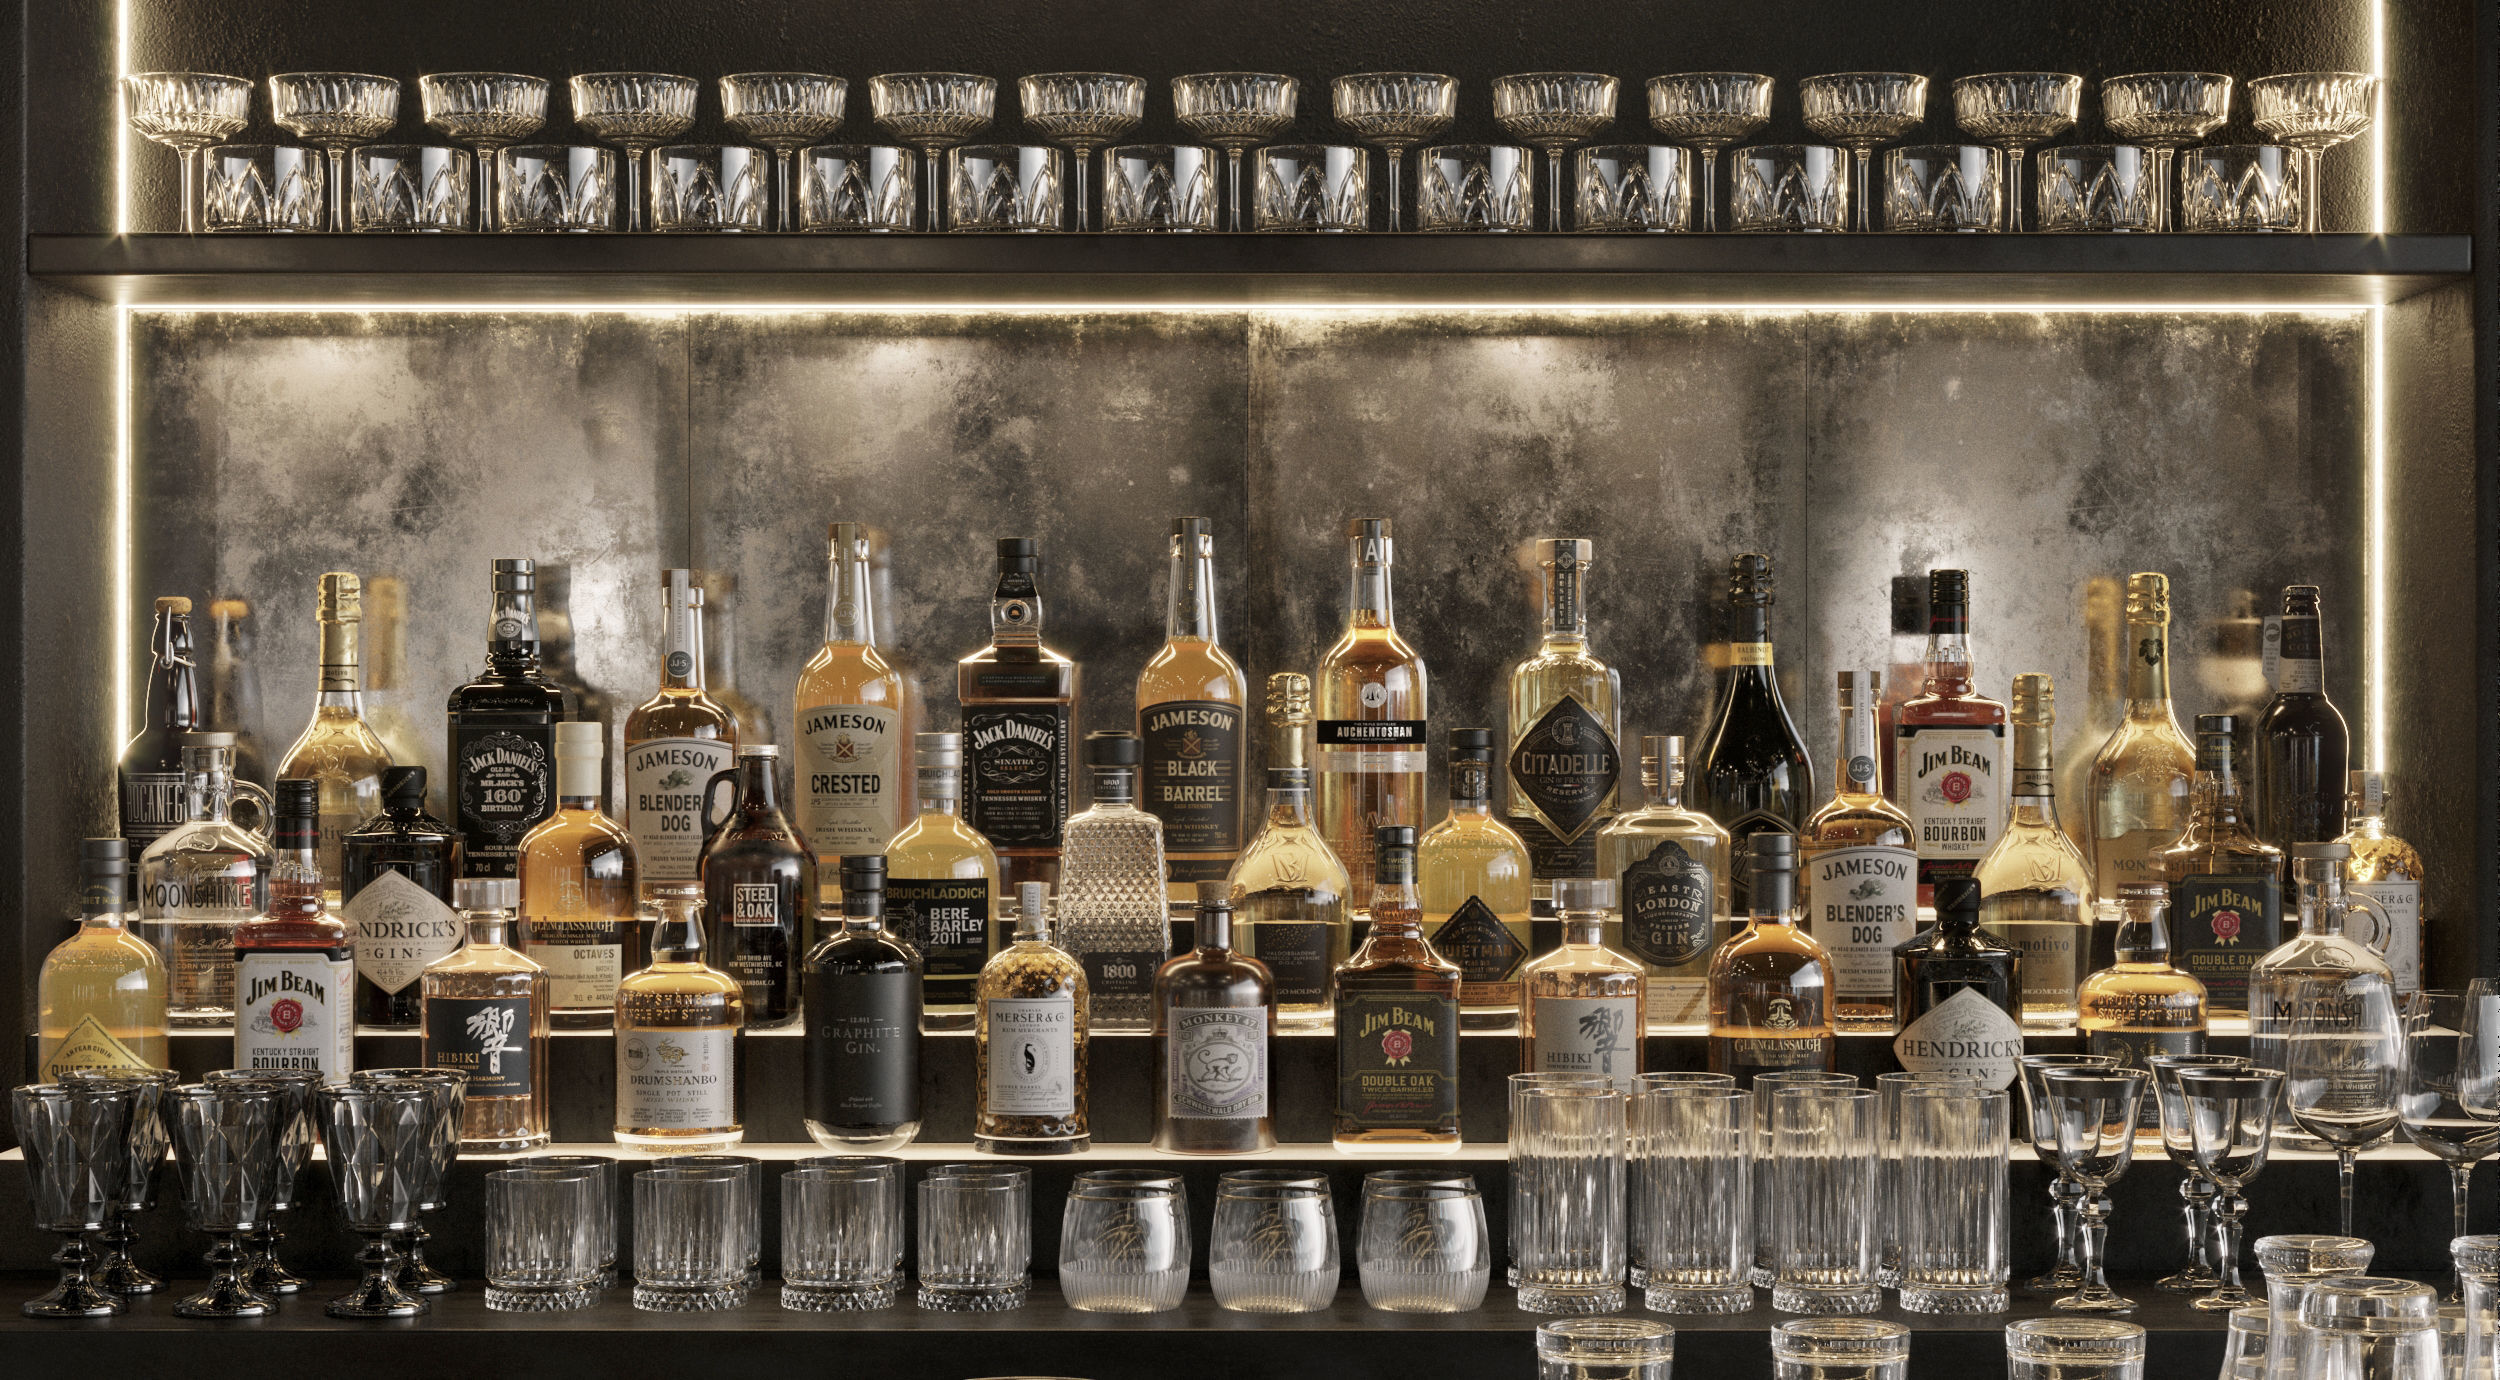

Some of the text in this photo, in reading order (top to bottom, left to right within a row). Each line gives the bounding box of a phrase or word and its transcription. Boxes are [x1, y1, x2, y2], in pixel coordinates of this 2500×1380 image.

[1365, 538, 1379, 562] A
[805, 714, 886, 735] JAMESON
[1150, 710, 1233, 732] JAMESON
[973, 719, 1056, 751] JACK DANIEL'S
[1336, 726, 1413, 738] AUCHENTOSHAN
[470, 752, 495, 774] JACK
[636, 749, 719, 772] JAMESON
[994, 758, 1035, 766] SINATRA
[1168, 760, 1218, 777] BLACK
[1522, 752, 1610, 775] CITADELLE
[1918, 745, 1991, 780] JIM BEAM
[811, 774, 881, 794] CRESTED
[1564, 776, 1596, 784] FRANCE
[1164, 785, 1224, 802] BARREL
[1545, 785, 1590, 796] RESERVE
[640, 795, 704, 811] BLENDER
[661, 815, 691, 832] DOG
[1924, 817, 1986, 825] KENTUCKY STRAIGHT
[1924, 826, 1986, 842] BOURBON
[1941, 842, 1971, 851] WHISKEY
[1822, 858, 1908, 882] JAMESON
[143, 884, 253, 908] MOONSHINE
[886, 887, 986, 900] BRUICHLADDICH
[1647, 884, 1690, 895] EAST
[737, 887, 774, 918] STEEL & OAK
[1634, 897, 1702, 914] LONDON
[2190, 888, 2263, 919] JIM BEAM
[930, 907, 970, 920] BERE
[1826, 904, 1905, 922] BLENDER'S
[359, 920, 456, 939] NDRICK'S
[530, 920, 615, 933] GLENGLASSAUGH
[930, 919, 984, 932] BARLEY
[930, 932, 961, 944] 2011
[1651, 931, 1689, 946] GIN
[1852, 926, 1883, 944] DOG
[2019, 936, 2070, 952] motivo
[374, 948, 413, 959] GIN
[574, 949, 615, 960] OCTAVES
[2192, 954, 2235, 966] DOUBLE
[1102, 964, 1137, 979] 1800
[246, 977, 278, 1006] JIM
[281, 970, 325, 1006] BEAM
[1290, 987, 1322, 995] MOLINO
[995, 1013, 1043, 1023] MERSER
[1182, 1013, 1257, 1029] MONKEY 47
[1360, 1006, 1435, 1038] JIM BEAM
[822, 1025, 901, 1039] GRAPHITE
[252, 1048, 320, 1056] KENTUCKY STRAIGHT
[1734, 1038, 1822, 1053] GLENGLASSAUGH
[1903, 1038, 2022, 1059] HENDRICK'S
[437, 1052, 480, 1064] HIBIKI
[1546, 1051, 1592, 1064] HIBIKI
[630, 1074, 718, 1086] DRUMSHANBO
[1361, 1075, 1434, 1087] DOUBLE OAK
[1177, 1095, 1232, 1115] SCHWARZWALD
